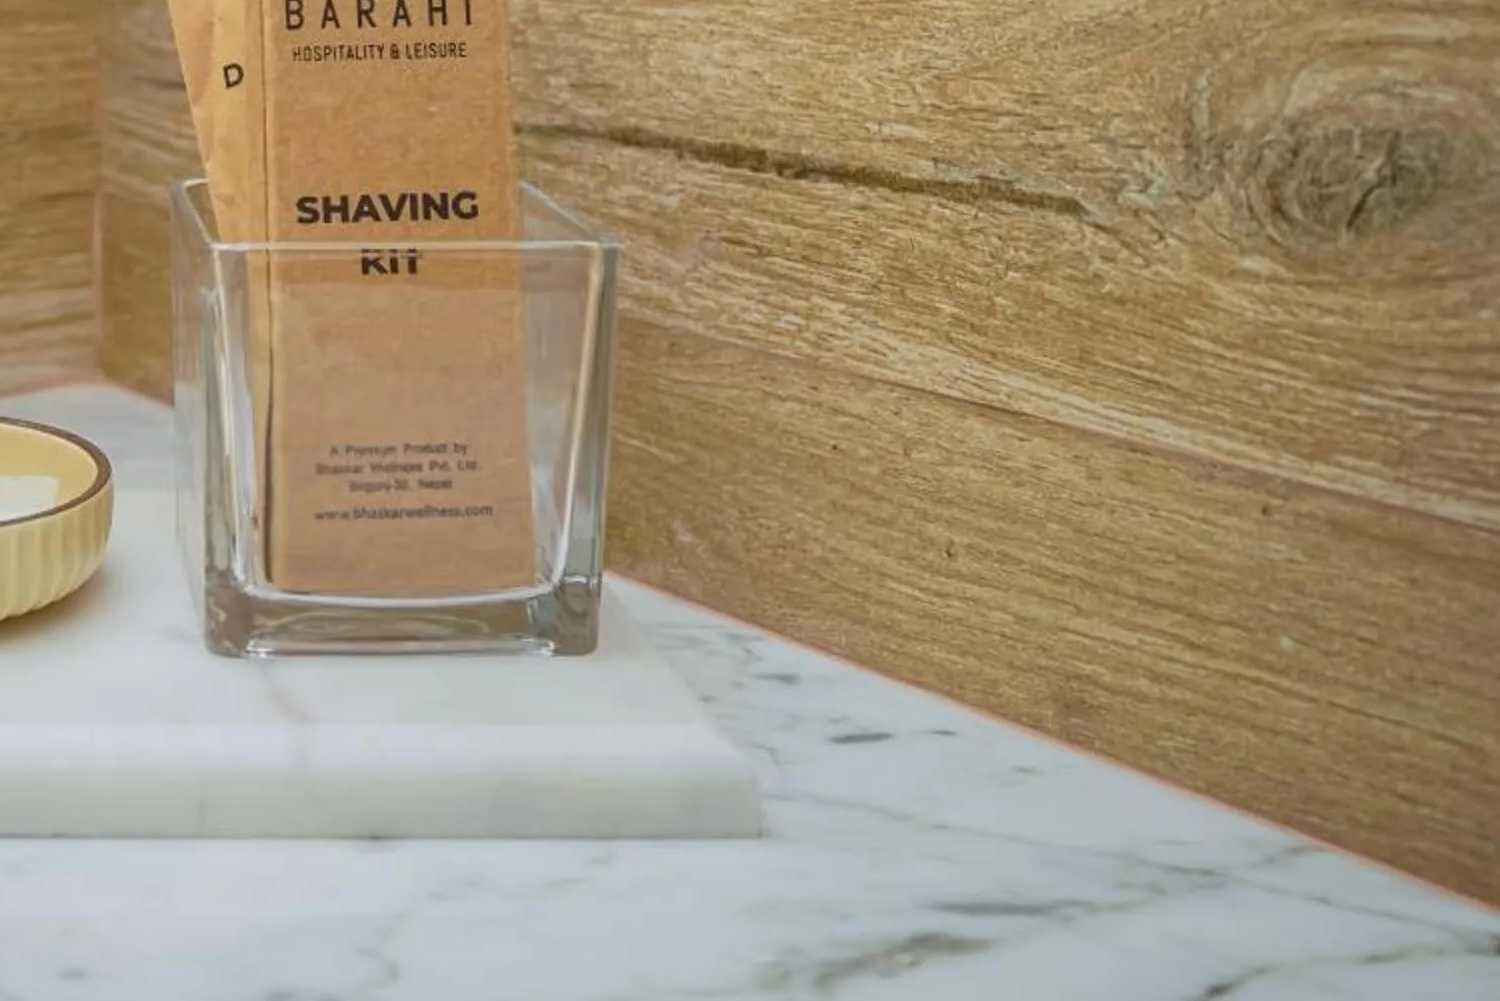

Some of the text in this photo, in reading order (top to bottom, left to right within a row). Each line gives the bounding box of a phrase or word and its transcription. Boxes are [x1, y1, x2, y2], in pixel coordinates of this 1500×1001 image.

[292, 42, 468, 62] HOSPITALITY & LEISURE
[295, 190, 479, 224] SHAVING
[360, 248, 420, 275] KIT
[329, 446, 339, 456] A
[404, 442, 448, 454] Product
[454, 443, 468, 456] by
